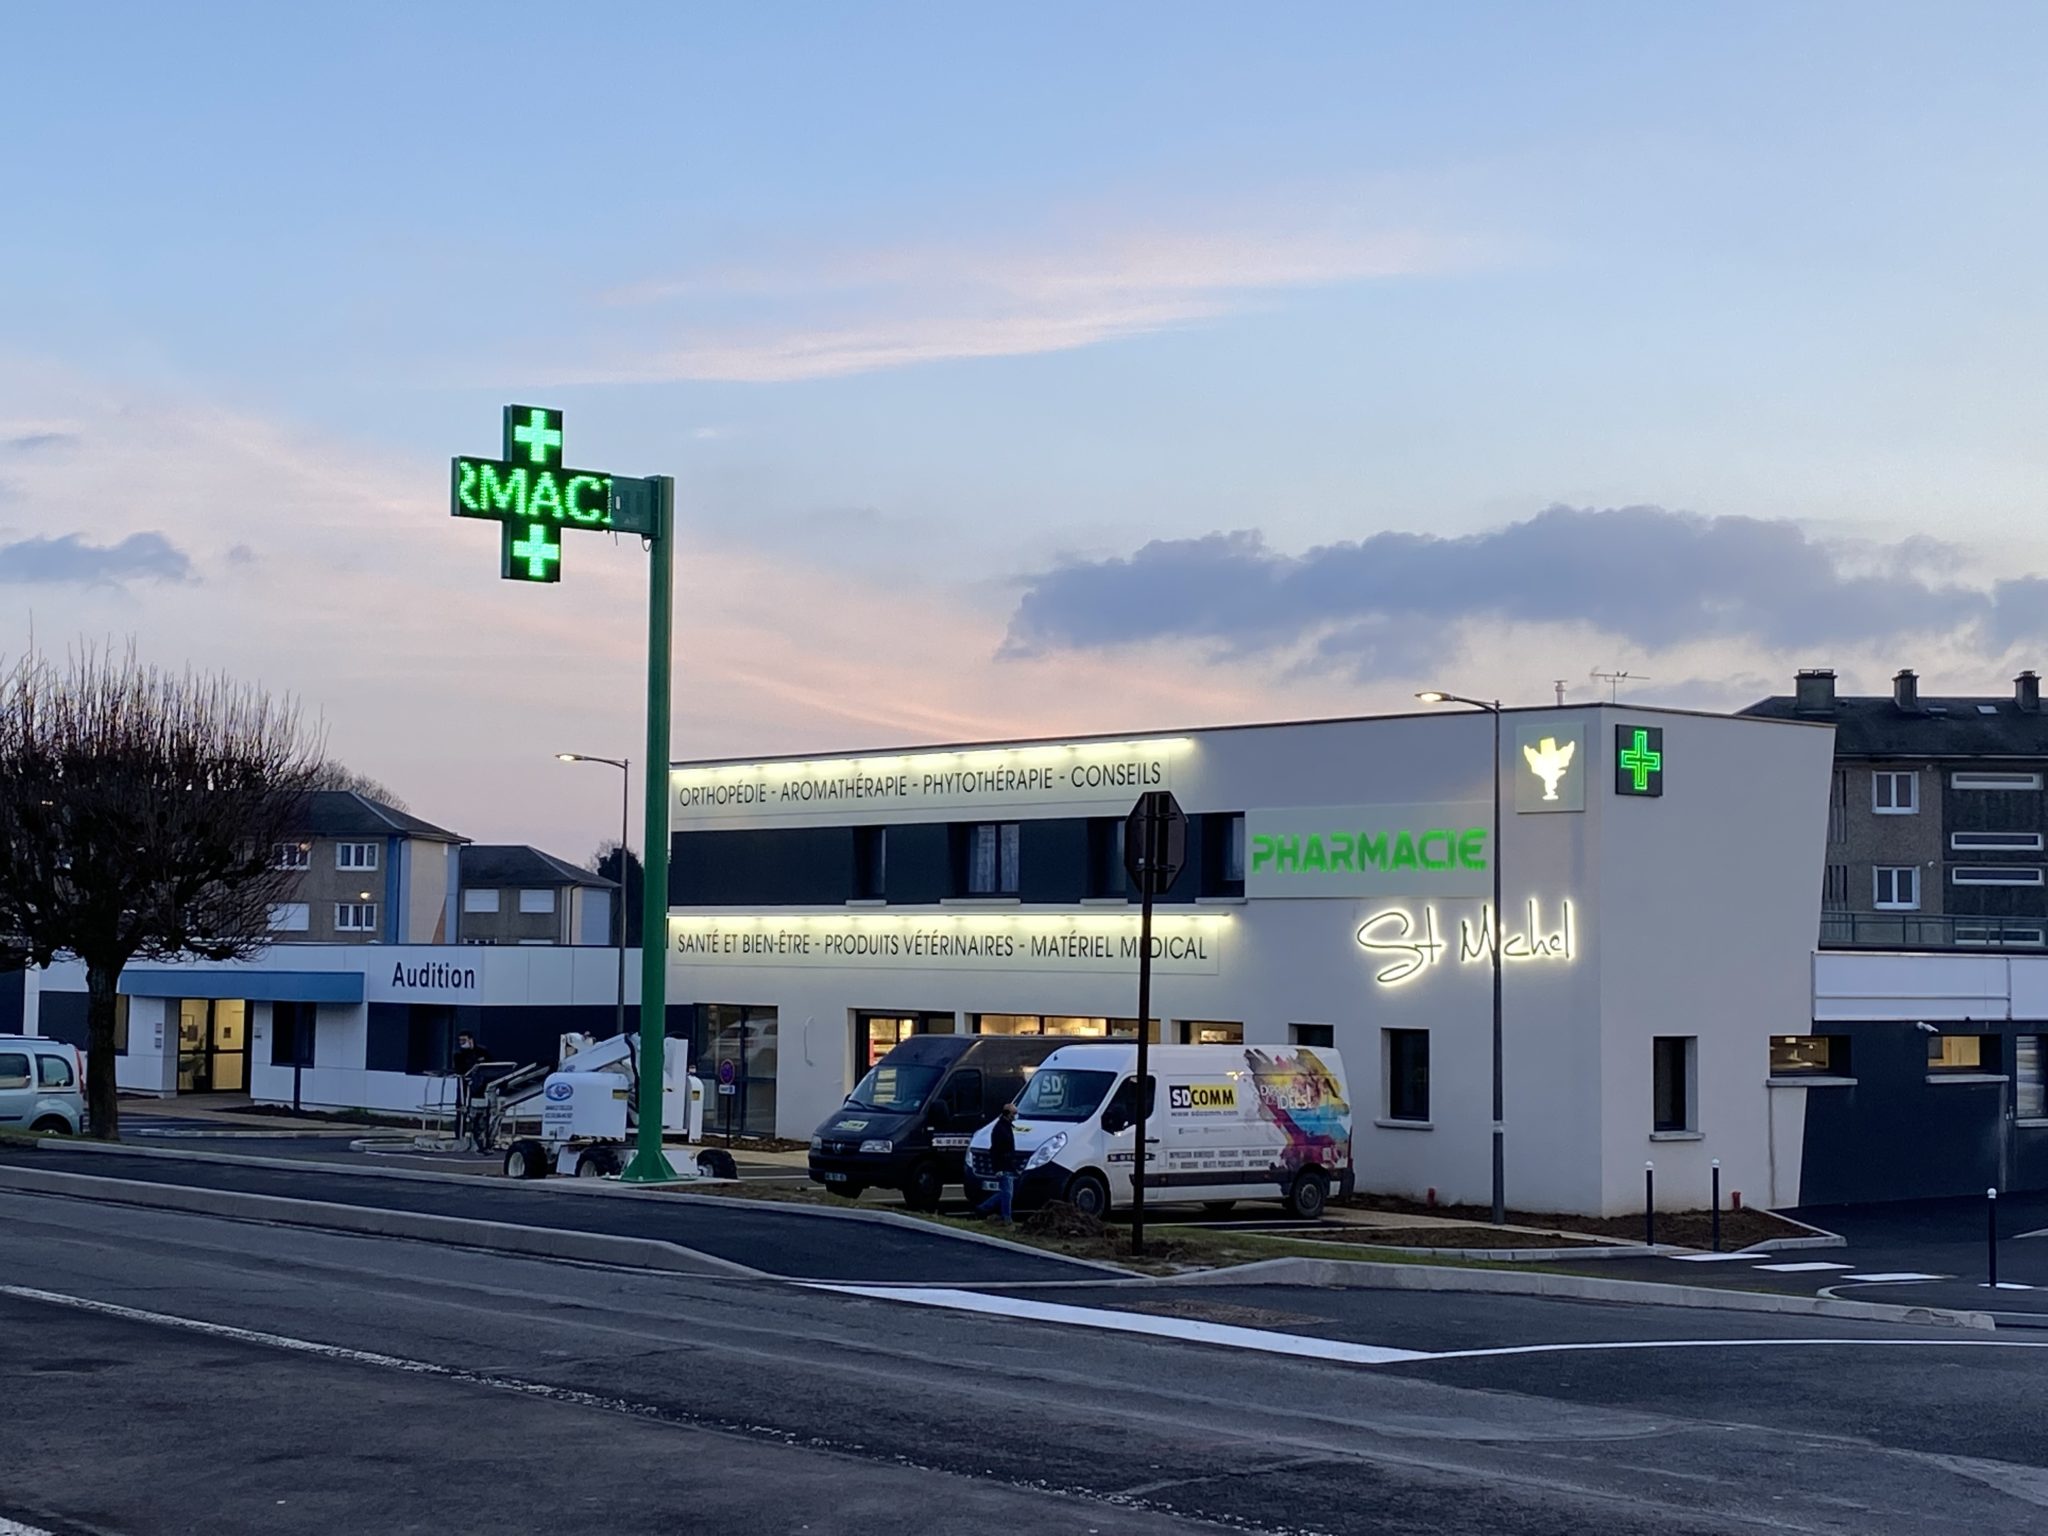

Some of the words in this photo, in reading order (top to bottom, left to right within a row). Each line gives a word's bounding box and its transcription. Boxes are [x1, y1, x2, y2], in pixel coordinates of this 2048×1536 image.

[680, 779, 766, 806] ORTHOPÉDIE
[780, 773, 907, 802] AROMATHÉRAPIE
[923, 764, 1053, 795] PHYTOTHÉRAPIE
[1071, 761, 1161, 788] CONSEILS
[1252, 827, 1488, 874] PHARMACIE
[677, 929, 719, 954] SANTÉ
[724, 934, 738, 953] ET
[742, 930, 810, 954] BIEN-ÊTRE
[825, 934, 899, 955] PRODUITS
[904, 929, 1014, 957] VÉTÉRINAIRES
[1031, 930, 1114, 959] MATÉRIEL
[1120, 935, 1207, 960] MDICAL
[1356, 906, 1443, 983] St
[1461, 899, 1571, 968] Mchel
[392, 961, 475, 989] Audition
